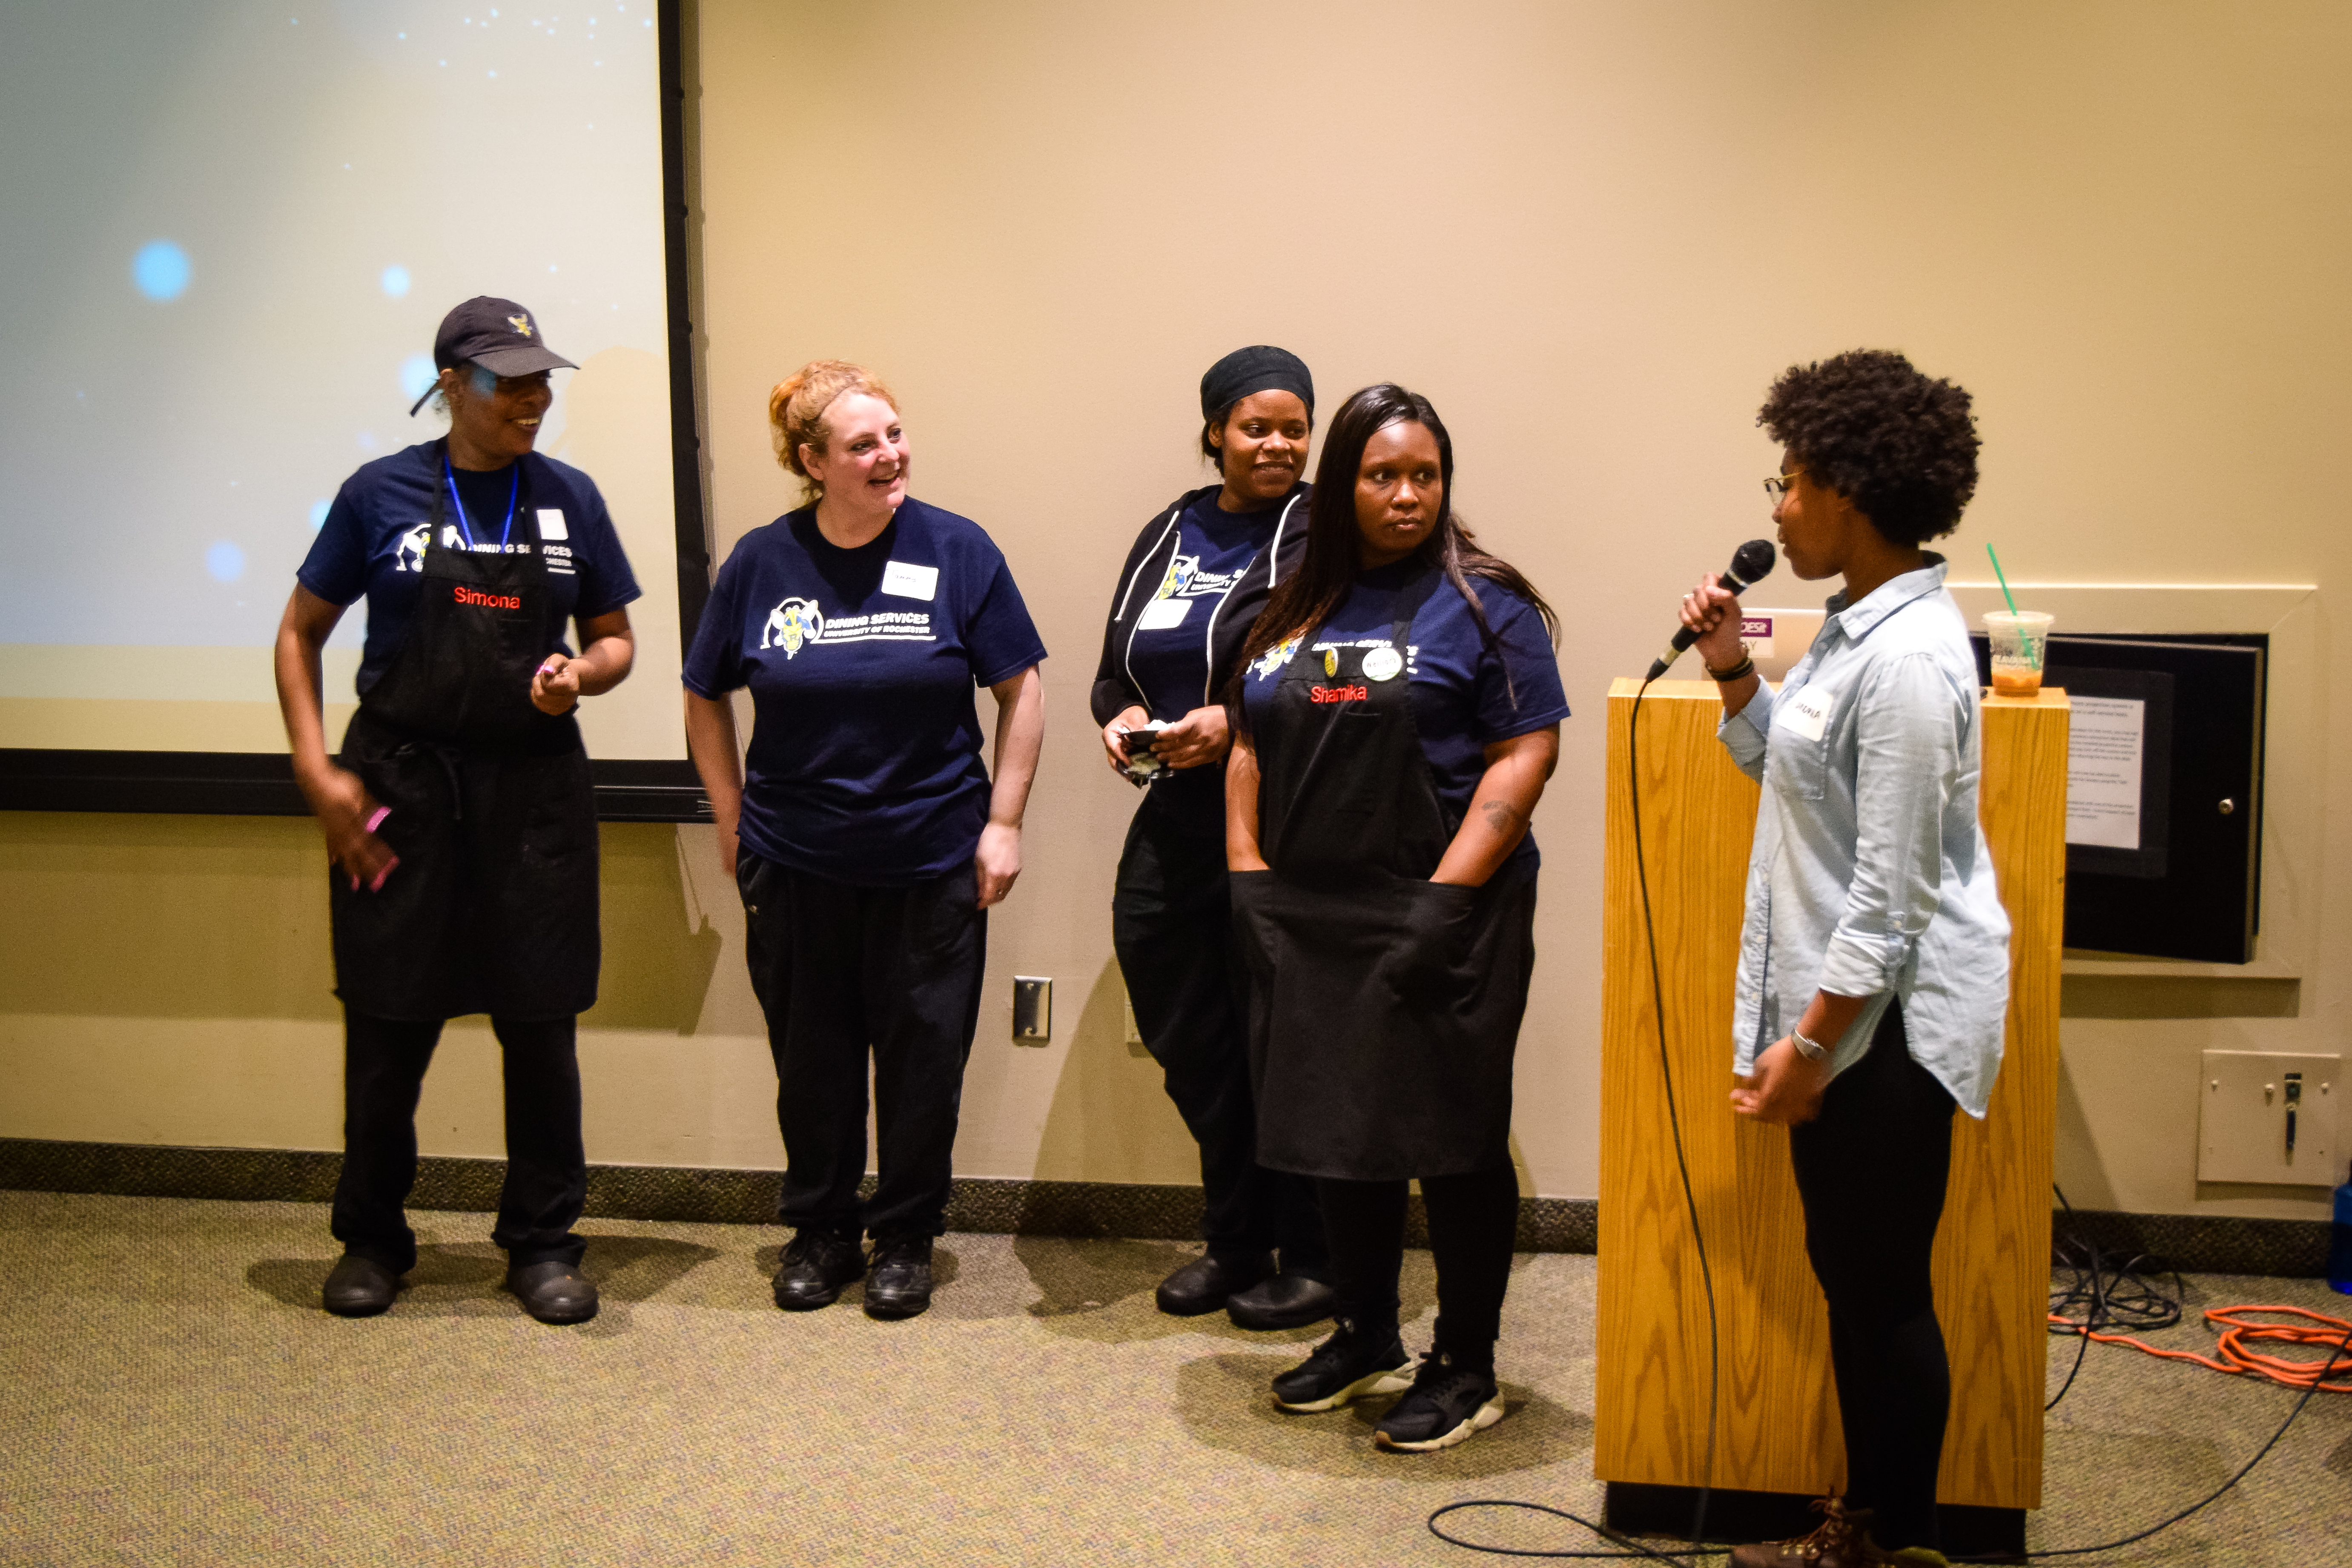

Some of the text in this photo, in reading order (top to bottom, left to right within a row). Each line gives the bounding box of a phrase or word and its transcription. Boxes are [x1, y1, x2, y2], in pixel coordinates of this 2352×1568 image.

[454, 587, 520, 609] Simona
[825, 612, 929, 629] DINING SERVICES
[823, 627, 871, 637] UNIVERSITY
[883, 625, 930, 634] ROCHESTER
[1311, 684, 1367, 703] Shamika
